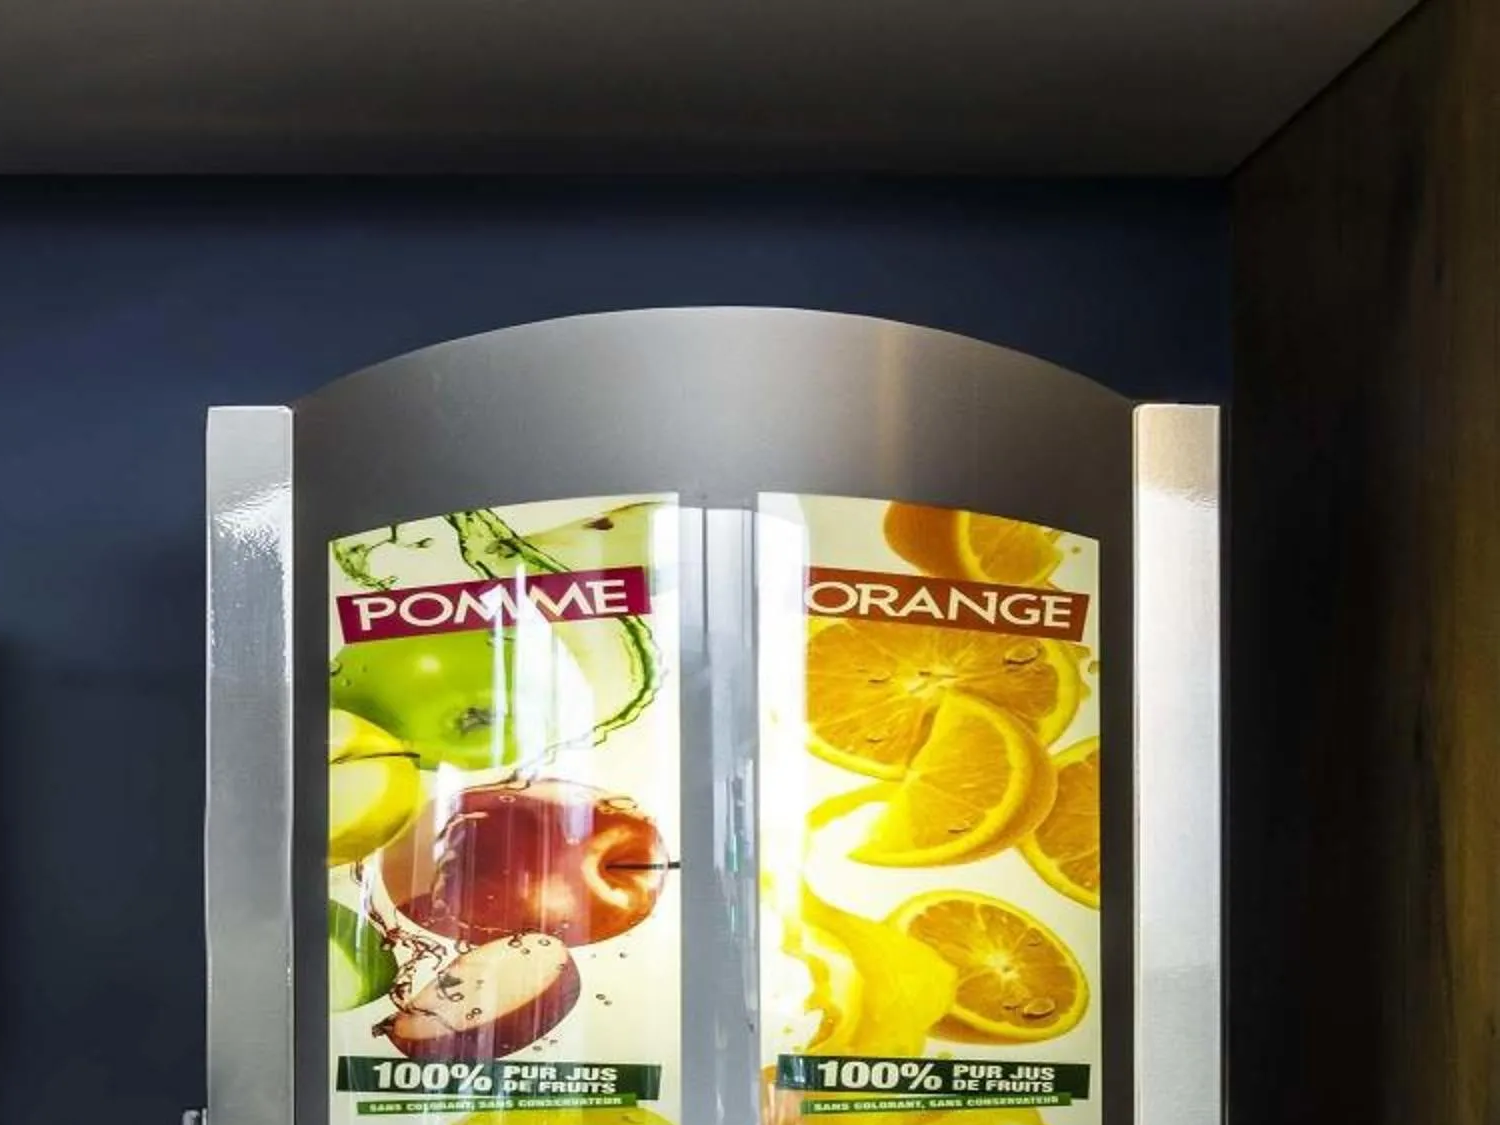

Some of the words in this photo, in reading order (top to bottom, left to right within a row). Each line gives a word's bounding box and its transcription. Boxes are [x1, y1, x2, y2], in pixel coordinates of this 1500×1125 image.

[351, 579, 629, 632] POMME
[803, 580, 1073, 629] ORANGE
[372, 1061, 493, 1092] 100%
[503, 1064, 557, 1080] PUR
[565, 1067, 617, 1081] JUS
[817, 1060, 943, 1091] 100%
[952, 1063, 1003, 1079] PUR
[1008, 1066, 1056, 1081] JUS
[503, 1080, 533, 1094] DE
[538, 1080, 617, 1095] FRUITS
[951, 1079, 980, 1092] DE
[985, 1079, 1054, 1093] FRUITS
[369, 1102, 403, 1113] SANS
[813, 1102, 850, 1112] SANS
[929, 1098, 963, 1108] SANS
